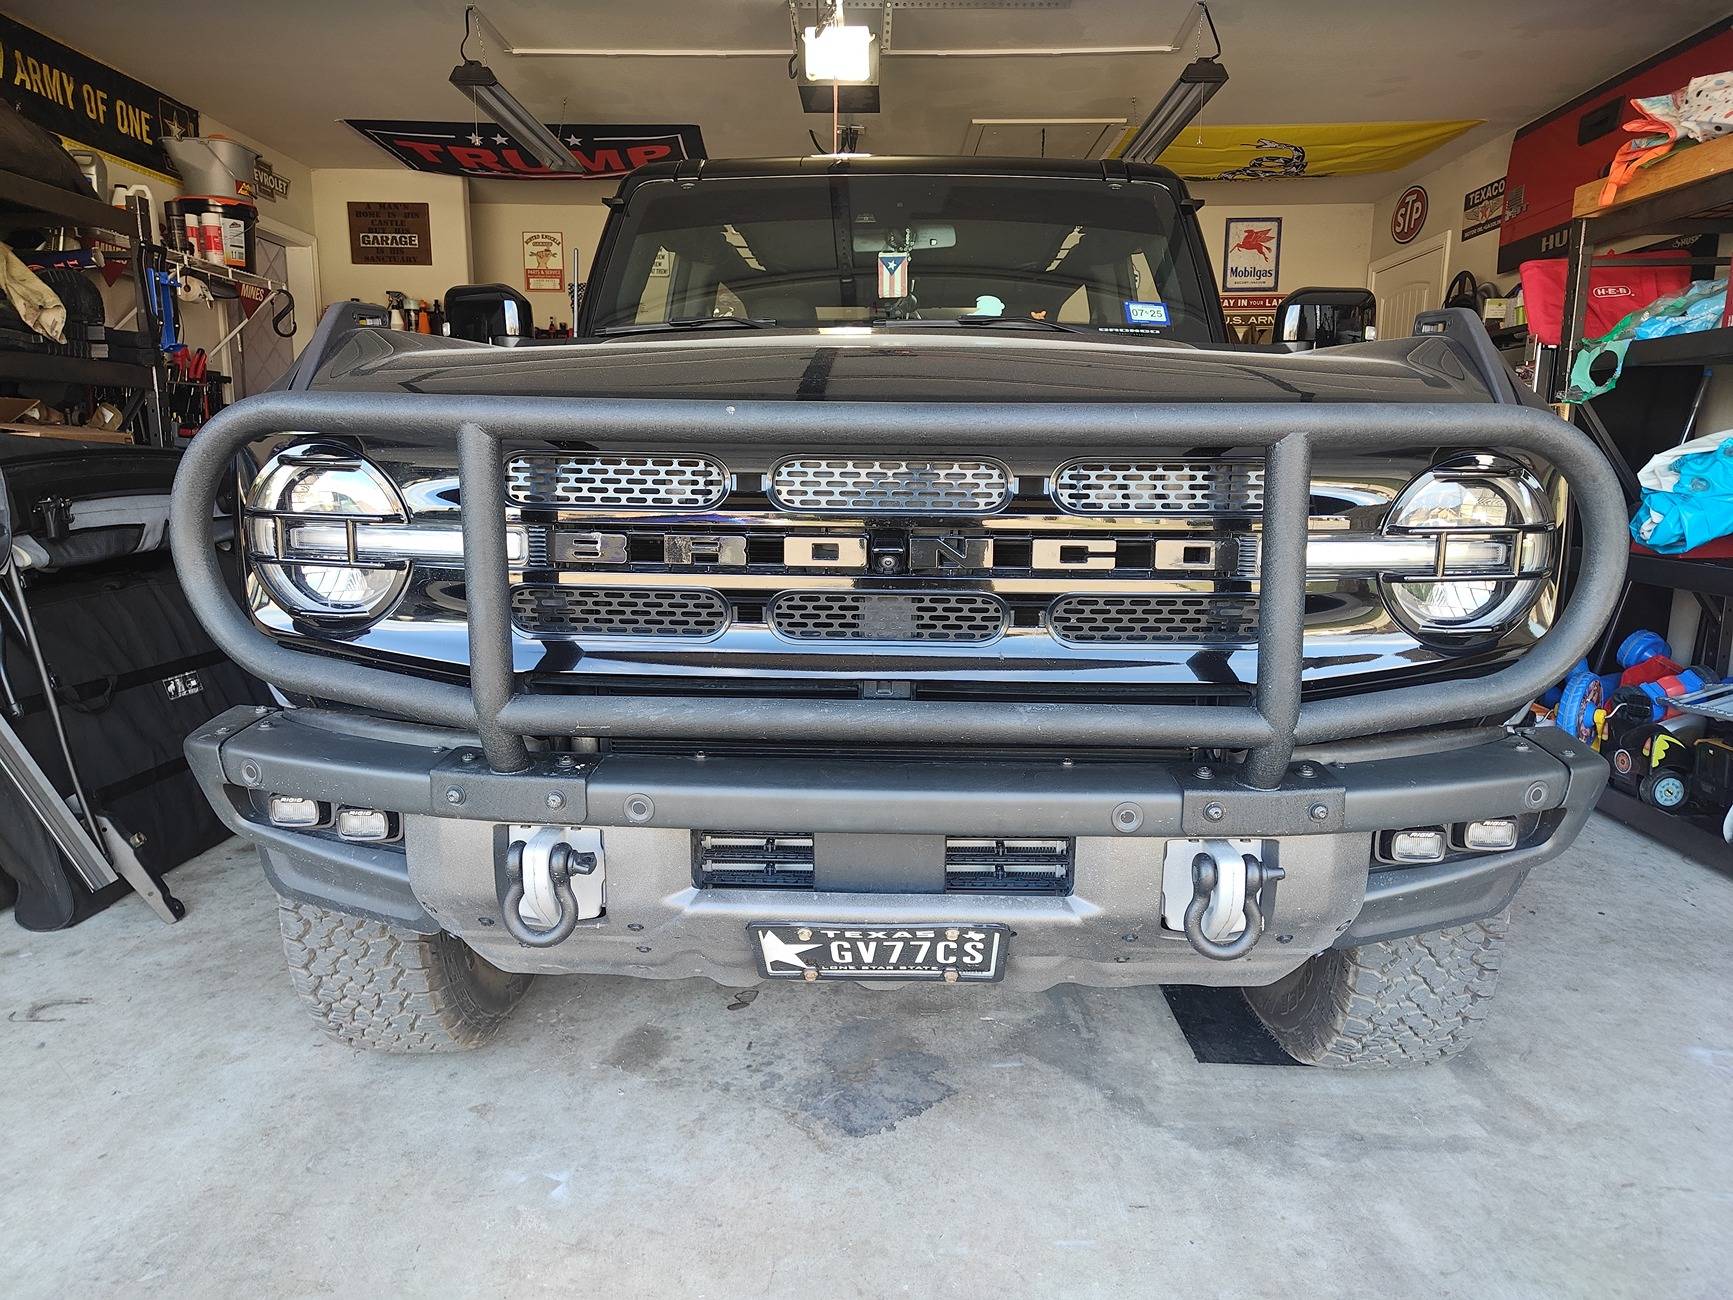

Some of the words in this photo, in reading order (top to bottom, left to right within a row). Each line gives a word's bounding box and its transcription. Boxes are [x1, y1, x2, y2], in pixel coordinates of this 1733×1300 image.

[14, 50, 75, 110] ARMY
[82, 83, 108, 125] OF
[115, 99, 153, 145] ONE
[393, 139, 672, 173] TRUMP
[254, 168, 287, 194] EVROLET
[1469, 180, 1506, 206] TEXACO
[1395, 193, 1422, 233] STP
[361, 234, 418, 246] GARAGE
[1230, 266, 1273, 280] Mobilgas
[241, 283, 264, 302] MINES
[1221, 299, 1236, 307] AY
[1237, 299, 1248, 307] IN
[1131, 308, 1144, 317] 07
[1149, 309, 1163, 318] 25
[555, 532, 1239, 570] BRONCO
[820, 930, 936, 939] TEXAS
[830, 941, 985, 964] GV77CS
